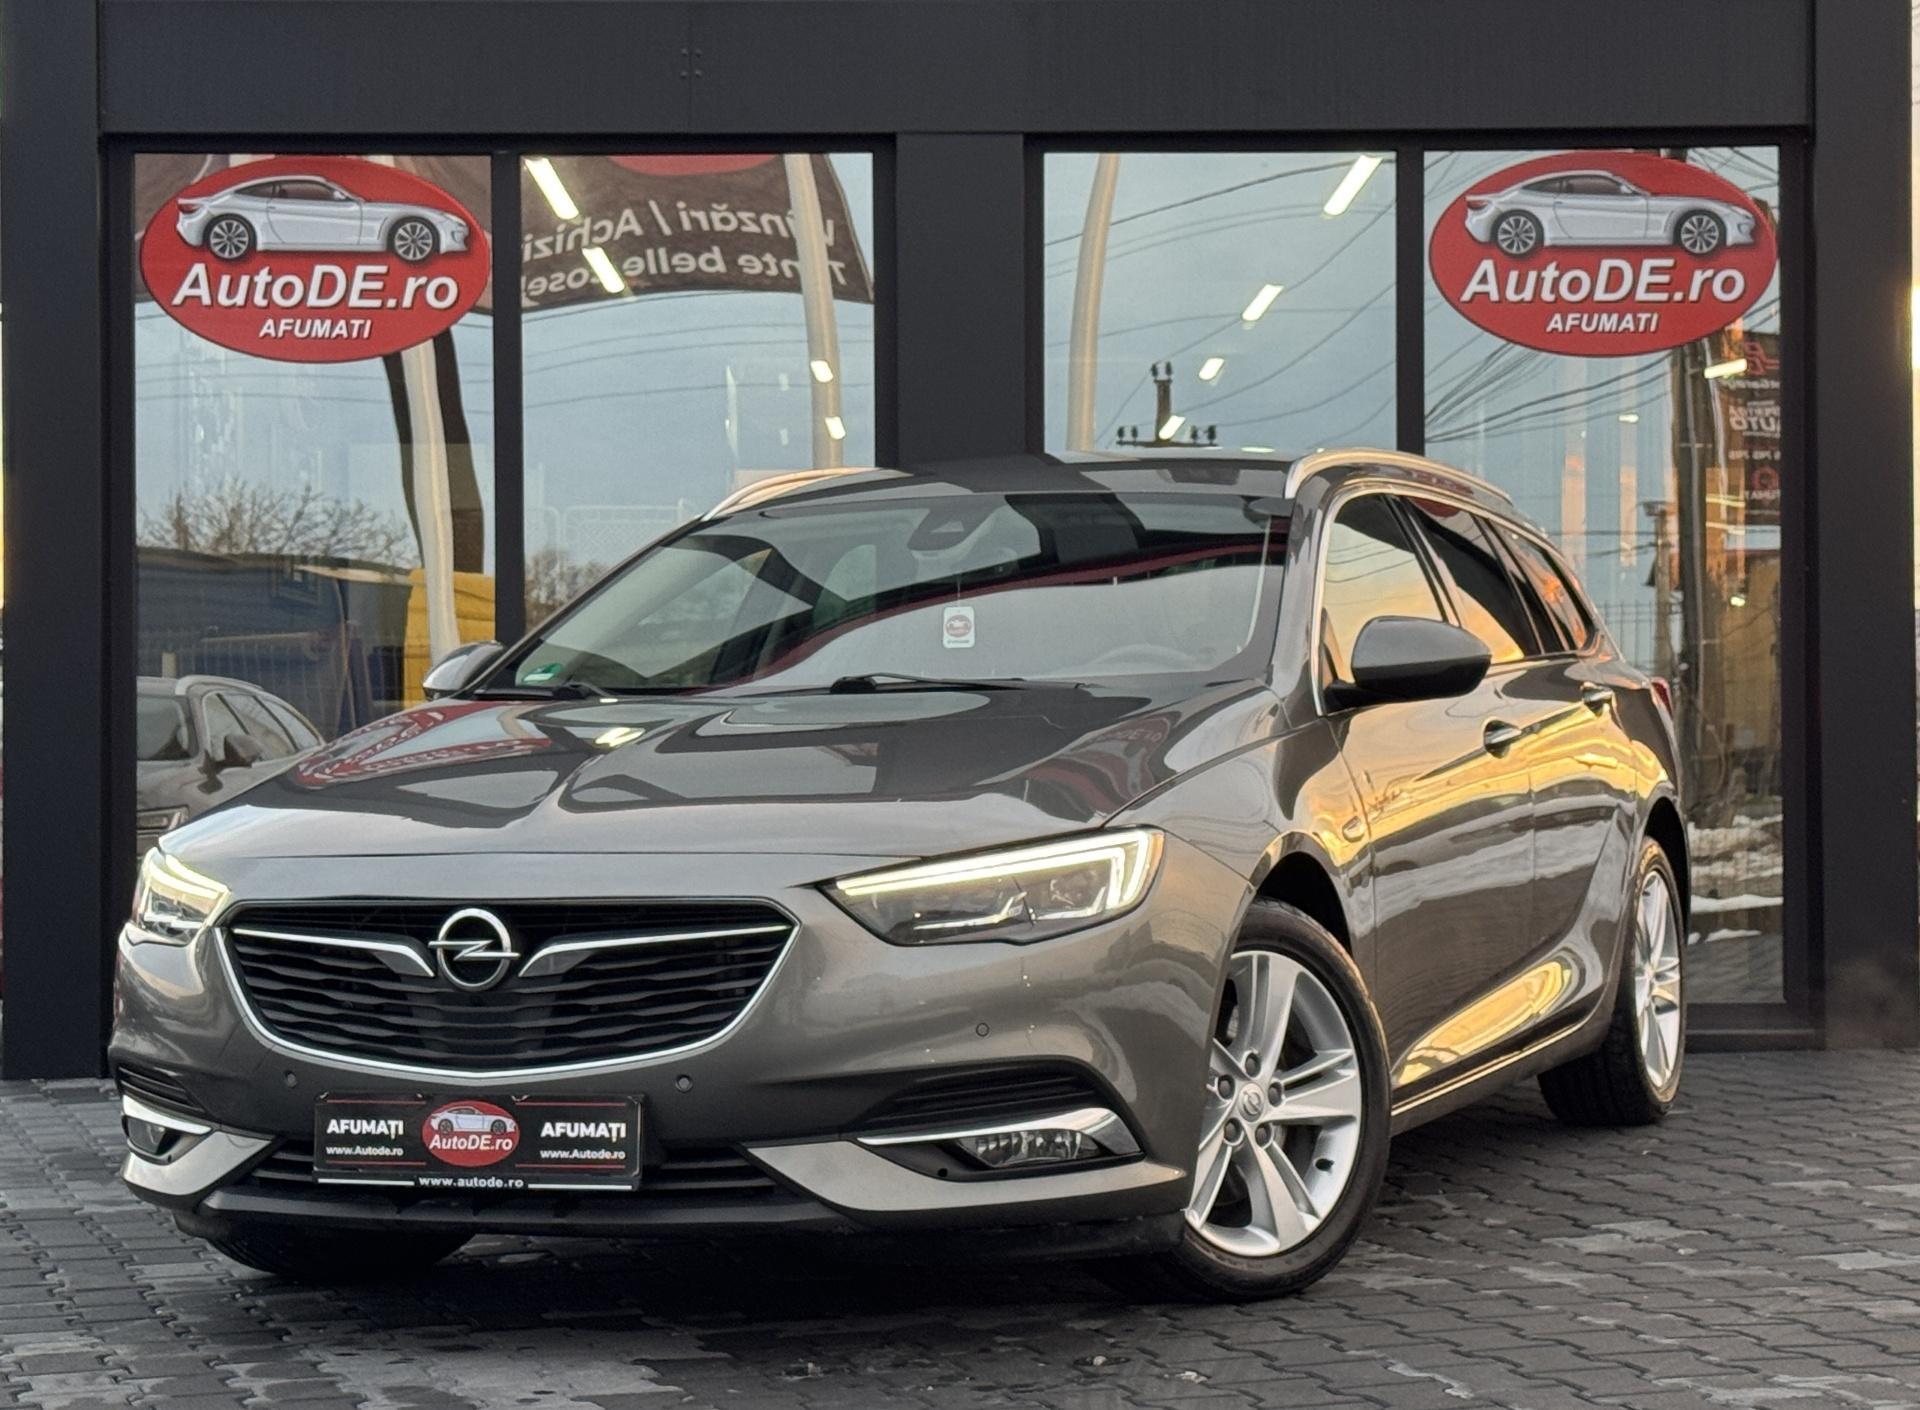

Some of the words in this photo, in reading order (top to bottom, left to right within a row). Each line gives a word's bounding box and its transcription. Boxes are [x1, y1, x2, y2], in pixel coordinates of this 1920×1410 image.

[172, 263, 459, 309] AutoDE.ro
[1460, 258, 1746, 303] AutoDE.ro
[259, 318, 373, 340] AFUMATI
[1546, 313, 1659, 333] AFUMATI
[326, 1119, 404, 1140] AFUMAȚI
[540, 1121, 627, 1143] AFUMAȚI
[325, 1145, 404, 1157] www.Autode.ro
[429, 1133, 513, 1152] AutoDE.ro
[540, 1148, 626, 1161] www.Autode.ro
[418, 1175, 525, 1190] www.autode.ro
